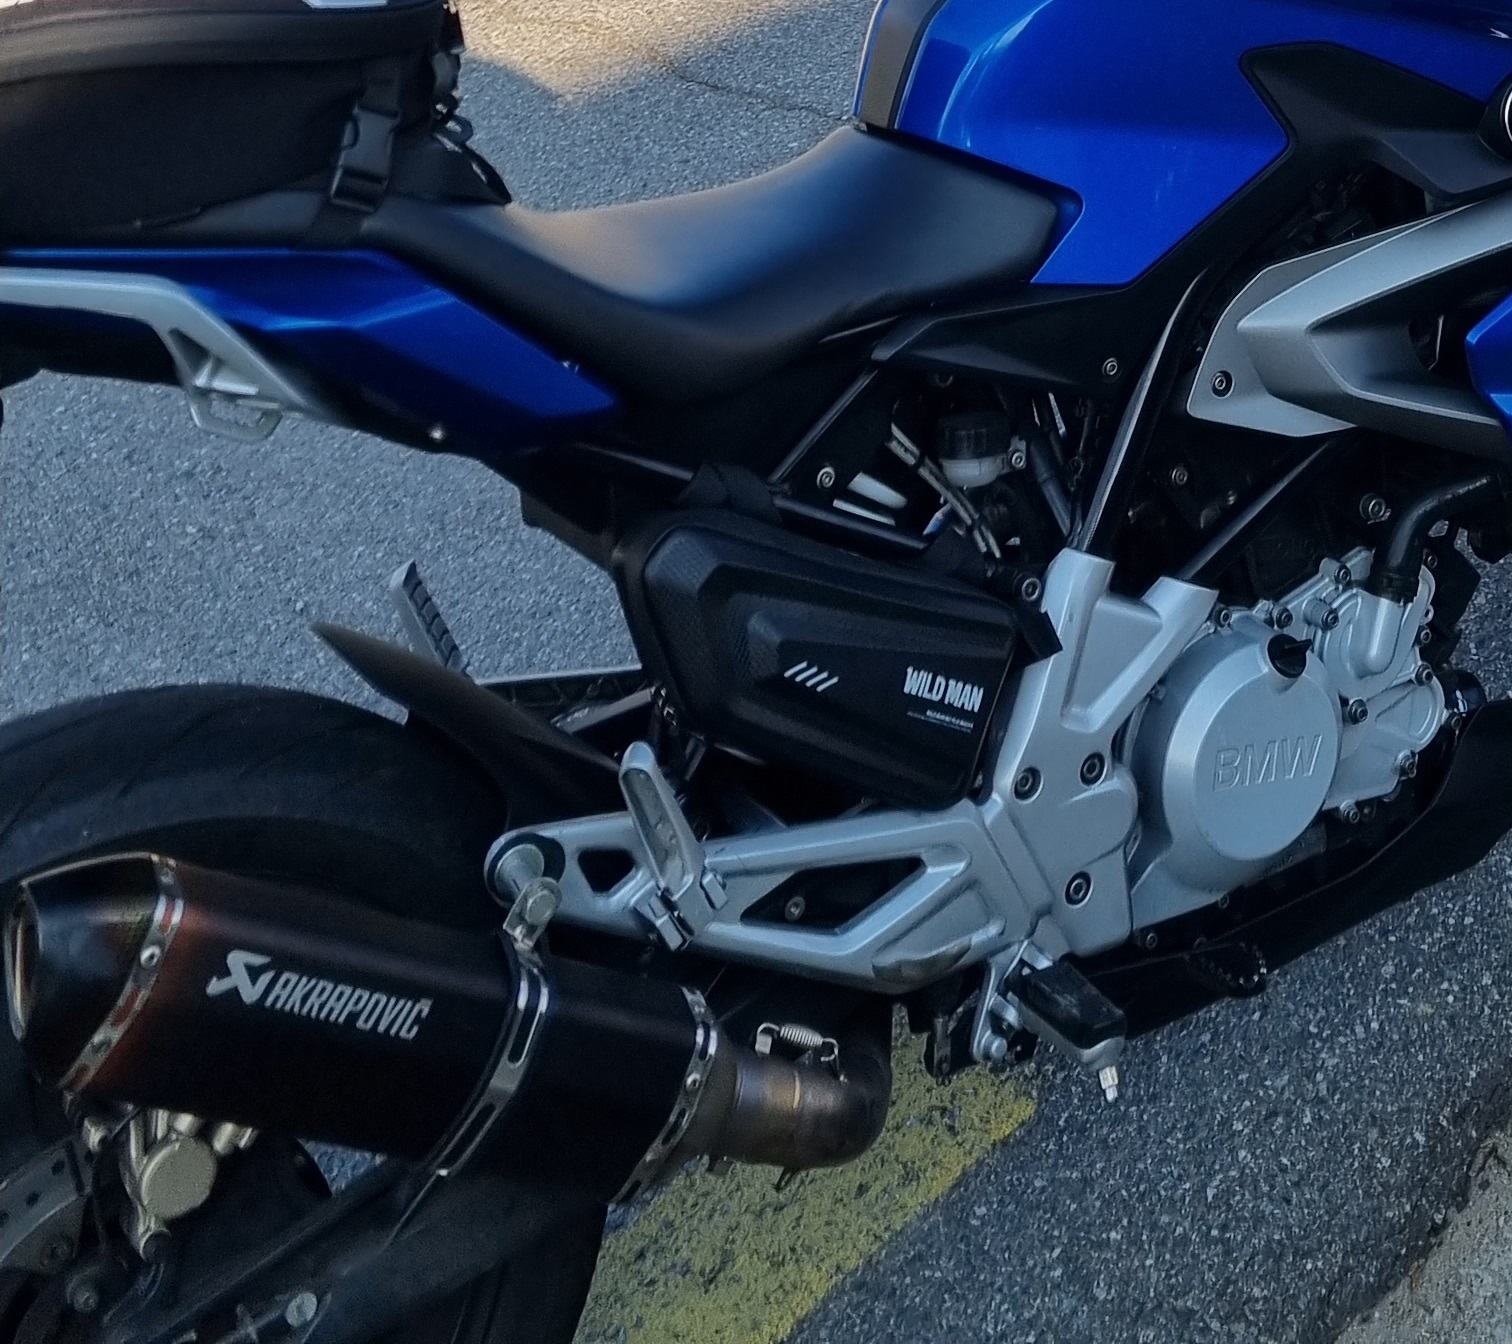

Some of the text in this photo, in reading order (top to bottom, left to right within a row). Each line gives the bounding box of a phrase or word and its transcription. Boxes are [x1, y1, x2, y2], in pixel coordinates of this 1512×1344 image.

[903, 665, 984, 713] WILD MAN
[1213, 734, 1323, 792] BMW
